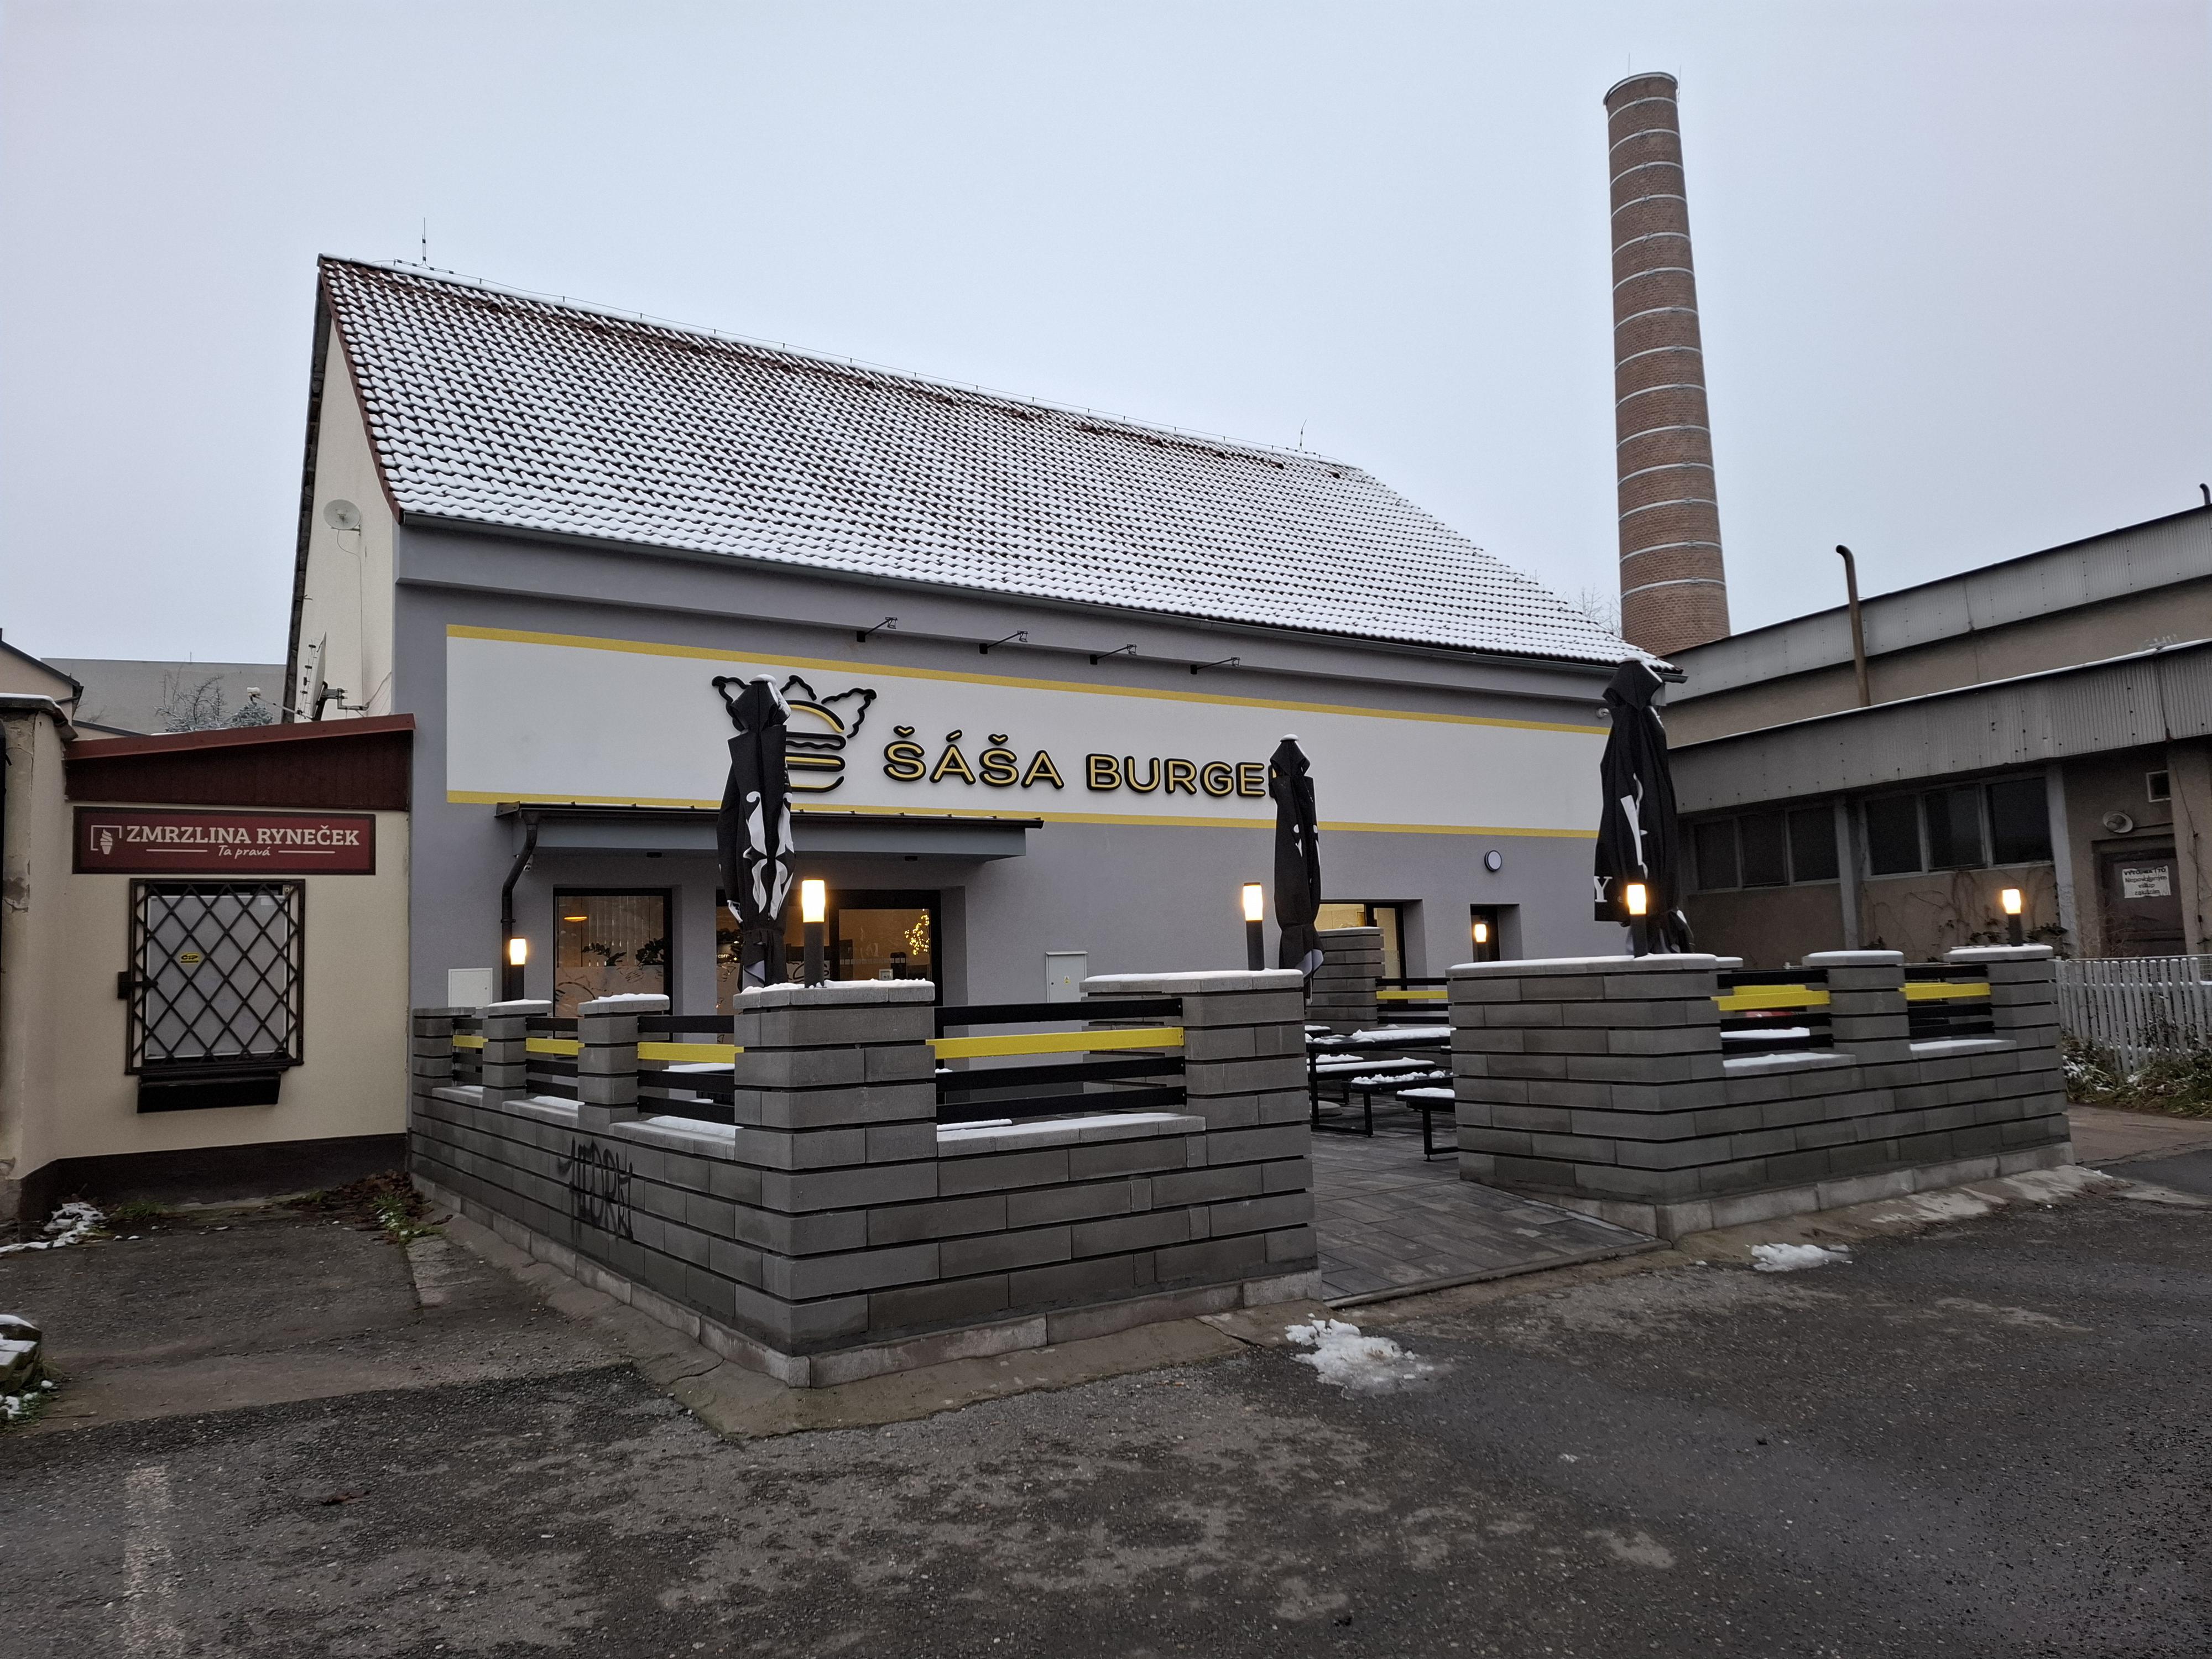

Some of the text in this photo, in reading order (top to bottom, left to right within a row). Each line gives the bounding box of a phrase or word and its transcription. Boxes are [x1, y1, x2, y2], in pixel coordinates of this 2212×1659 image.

[883, 725, 1277, 799] ŠÁŠA BURGE
[126, 825, 359, 846] ZMRZLINA RYNEČEK
[218, 845, 270, 859] Ta pravá
